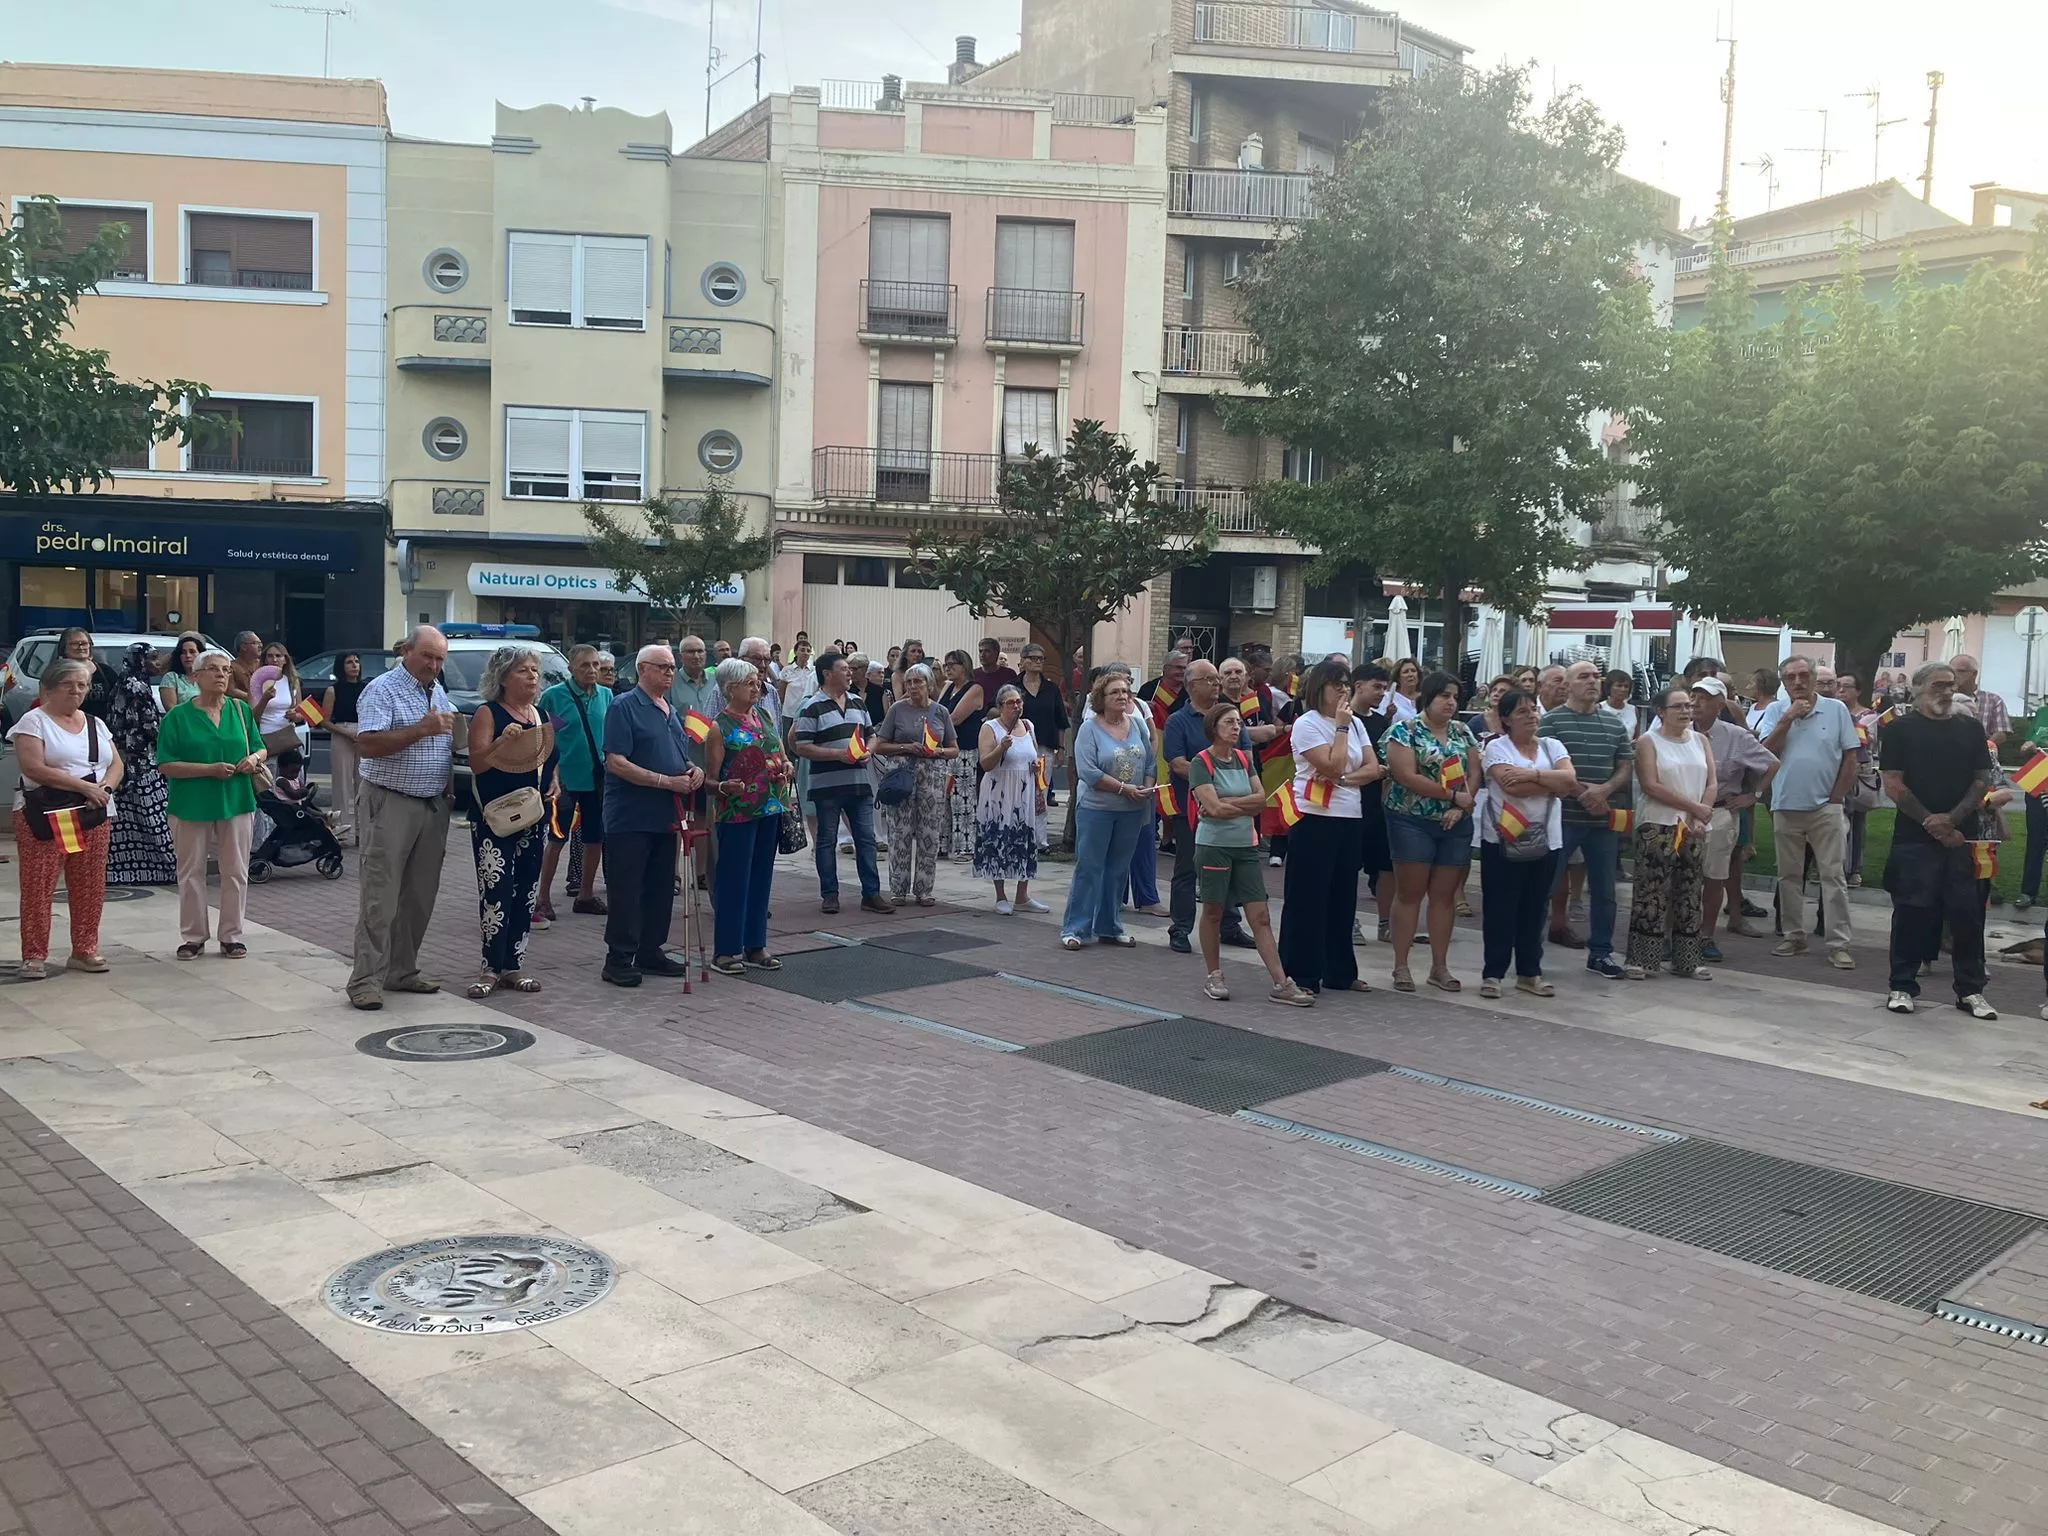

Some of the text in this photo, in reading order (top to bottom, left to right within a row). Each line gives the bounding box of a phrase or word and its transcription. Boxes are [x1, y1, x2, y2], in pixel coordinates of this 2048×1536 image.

[42, 521, 66, 532] drs.
[227, 549, 253, 558] Salud
[262, 551, 299, 560] estética
[300, 552, 329, 561] dental
[479, 571, 539, 586] Natural
[544, 574, 597, 589] Optics
[515, 1307, 568, 1326] CREER
[564, 1297, 589, 1308] EN
[378, 1319, 484, 1333] ENCUENTRO
